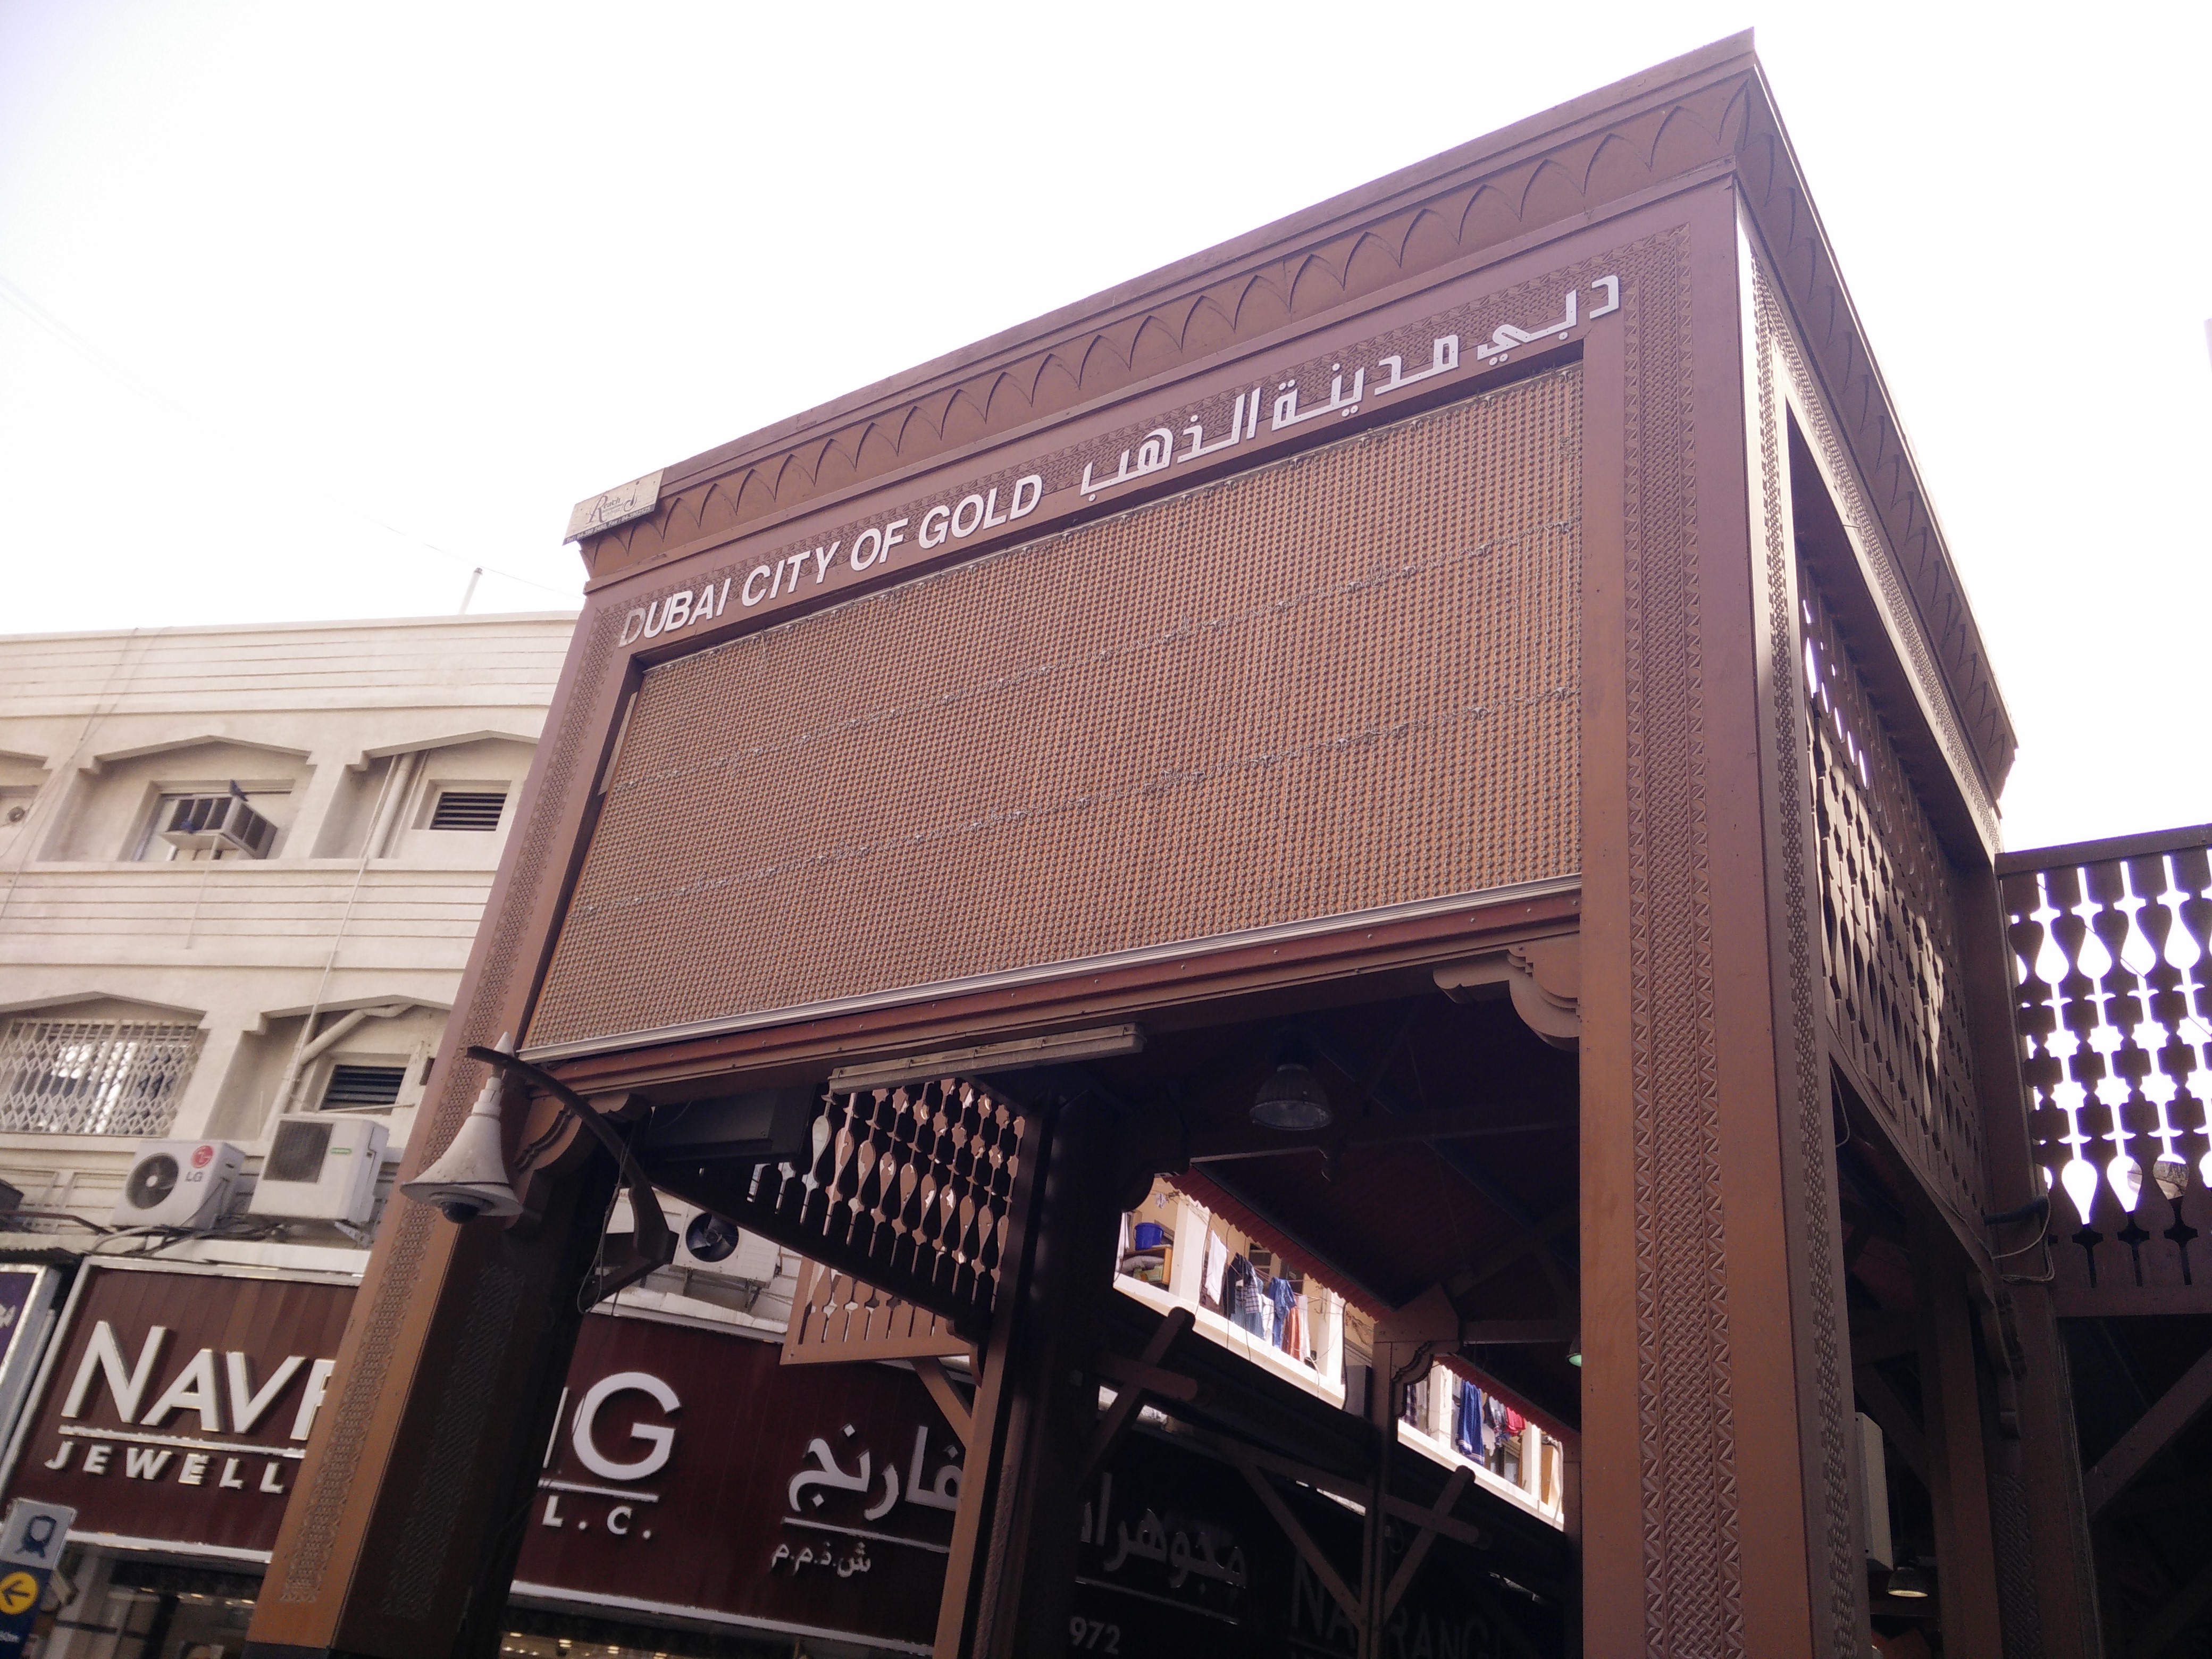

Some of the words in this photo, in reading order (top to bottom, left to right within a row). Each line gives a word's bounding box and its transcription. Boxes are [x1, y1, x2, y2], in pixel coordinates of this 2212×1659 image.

[1477, 275, 1620, 366] دبي
[1271, 334, 1459, 418] مدينة
[1080, 387, 1261, 501] الذهب
[585, 492, 621, 524] Reach
[618, 577, 731, 648] DUBAI
[741, 540, 841, 607] CITY
[850, 517, 909, 572] OF
[918, 474, 1042, 549] GOLD
[186, 1171, 203, 1182] LG
[45, 1440, 283, 1493] JEWELL
[1069, 1616, 1121, 1655] 972
